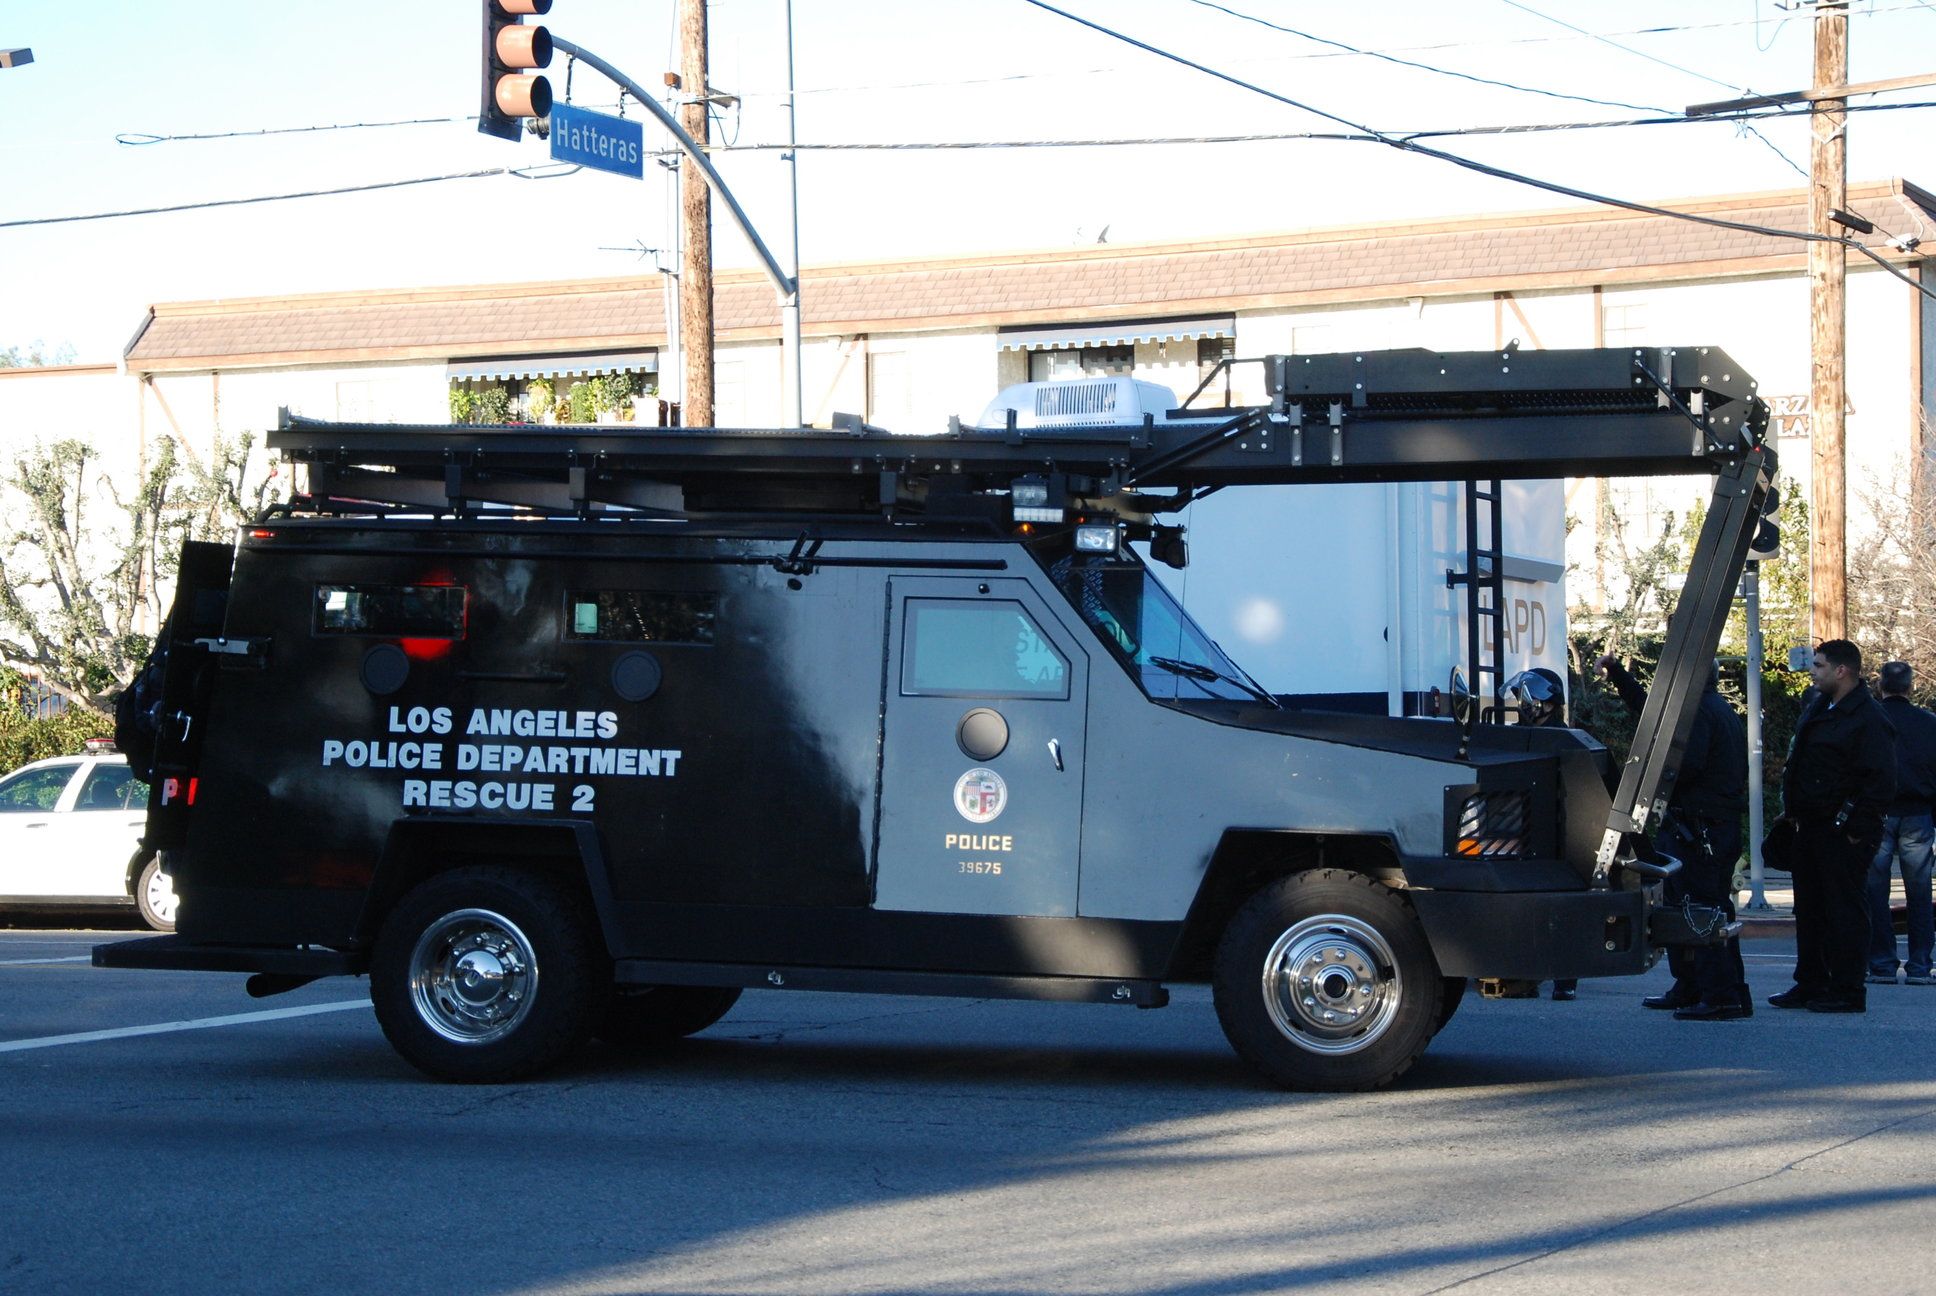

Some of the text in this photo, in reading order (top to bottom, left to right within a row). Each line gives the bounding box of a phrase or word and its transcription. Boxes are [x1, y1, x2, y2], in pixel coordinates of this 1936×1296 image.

[556, 117, 638, 164] Hatteras
[1481, 594, 1546, 657] LAPD
[389, 706, 619, 739] LOS ANGELES
[322, 740, 682, 777] POLICE DEPARTMENT
[403, 779, 596, 812] RESCUE 2
[945, 834, 1013, 852] POLICE
[958, 861, 1002, 875] 39675
